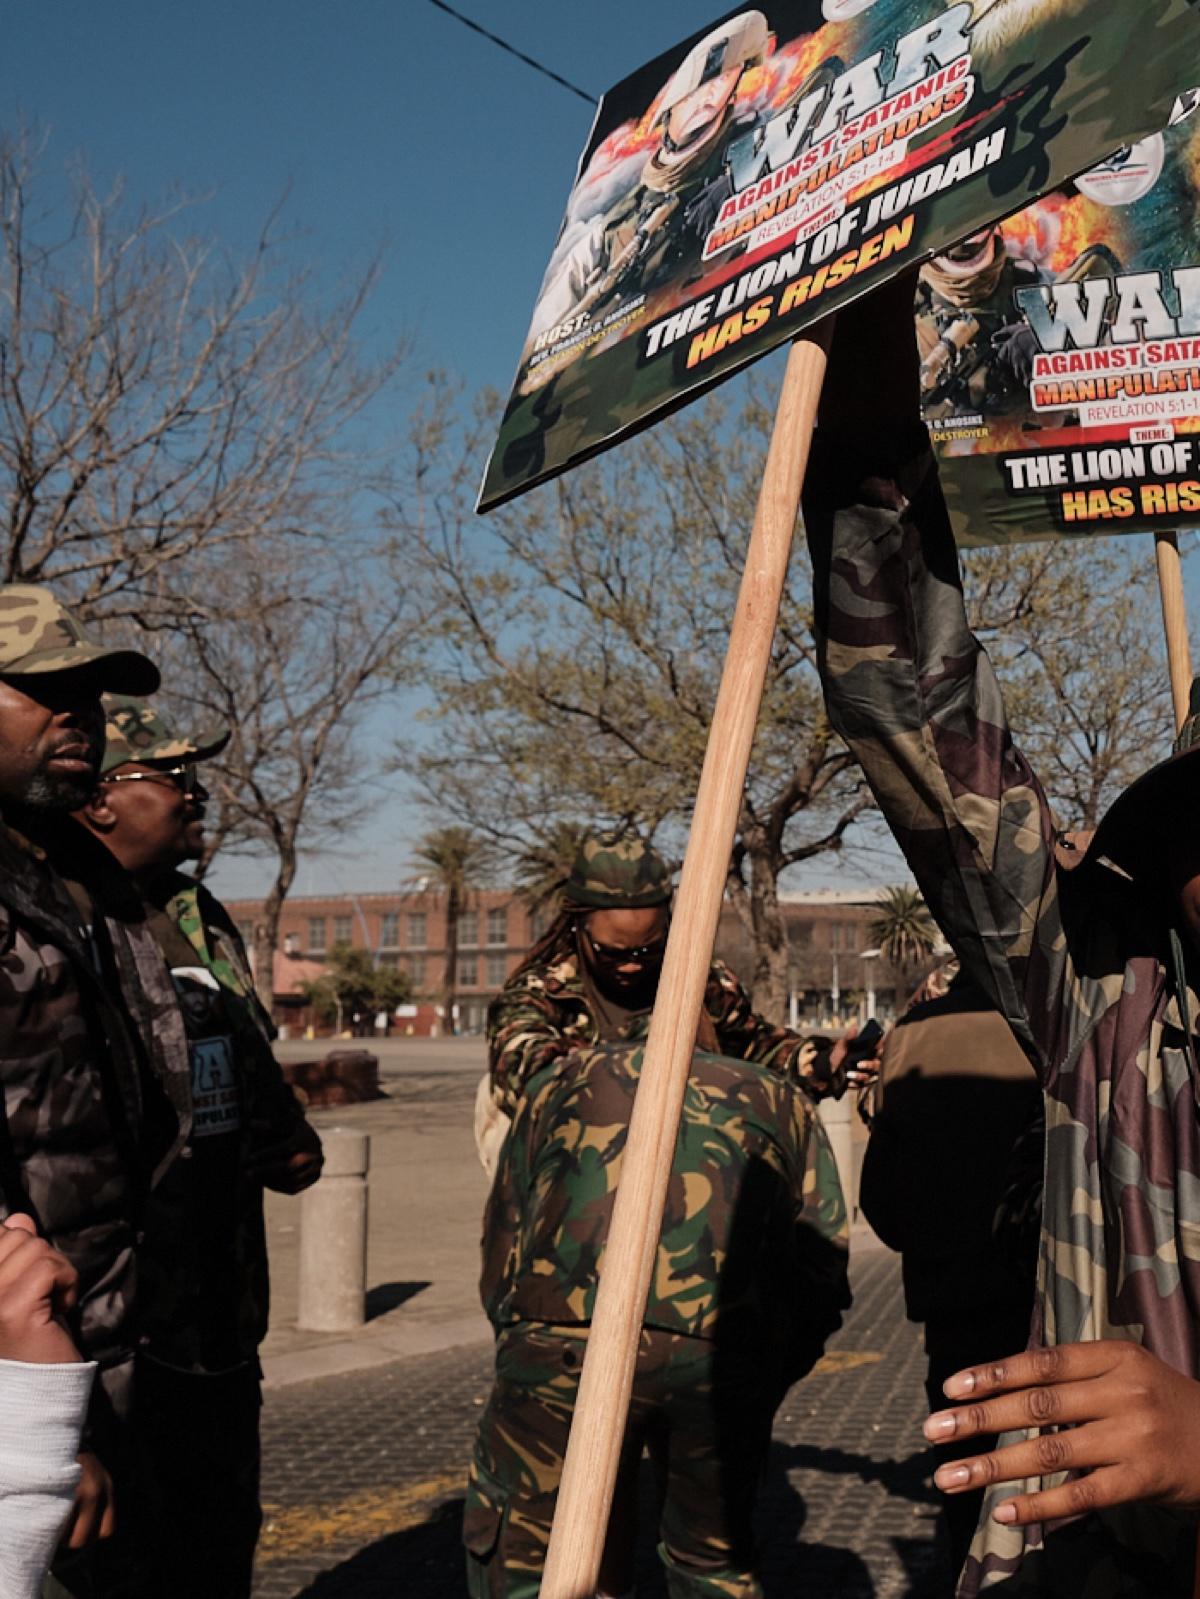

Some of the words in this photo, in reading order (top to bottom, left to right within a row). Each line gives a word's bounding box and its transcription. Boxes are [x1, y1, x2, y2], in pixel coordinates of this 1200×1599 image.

[726, 2, 972, 193] WAR
[719, 134, 835, 222] AGAINST
[840, 57, 969, 145] SATANIC
[706, 82, 968, 254] MANIPULATIONS
[757, 180, 845, 241] REVELATION
[848, 152, 896, 184] 5:1-14
[645, 294, 716, 359] THE
[714, 243, 807, 316] LION
[809, 206, 862, 266] OF
[861, 127, 1008, 234] JUDAH
[686, 294, 774, 370] HAS
[777, 213, 915, 315] RISEN
[533, 311, 591, 352] HOST:
[1035, 346, 1140, 376] AGAINST
[933, 427, 989, 441] DESTROYER
[1087, 400, 1167, 421] REVELATION
[1135, 428, 1170, 441] THEME:
[1005, 454, 1068, 489] THE
[1071, 446, 1146, 483] LION
[1151, 442, 1193, 475] OF
[1061, 487, 1136, 522] HAS
